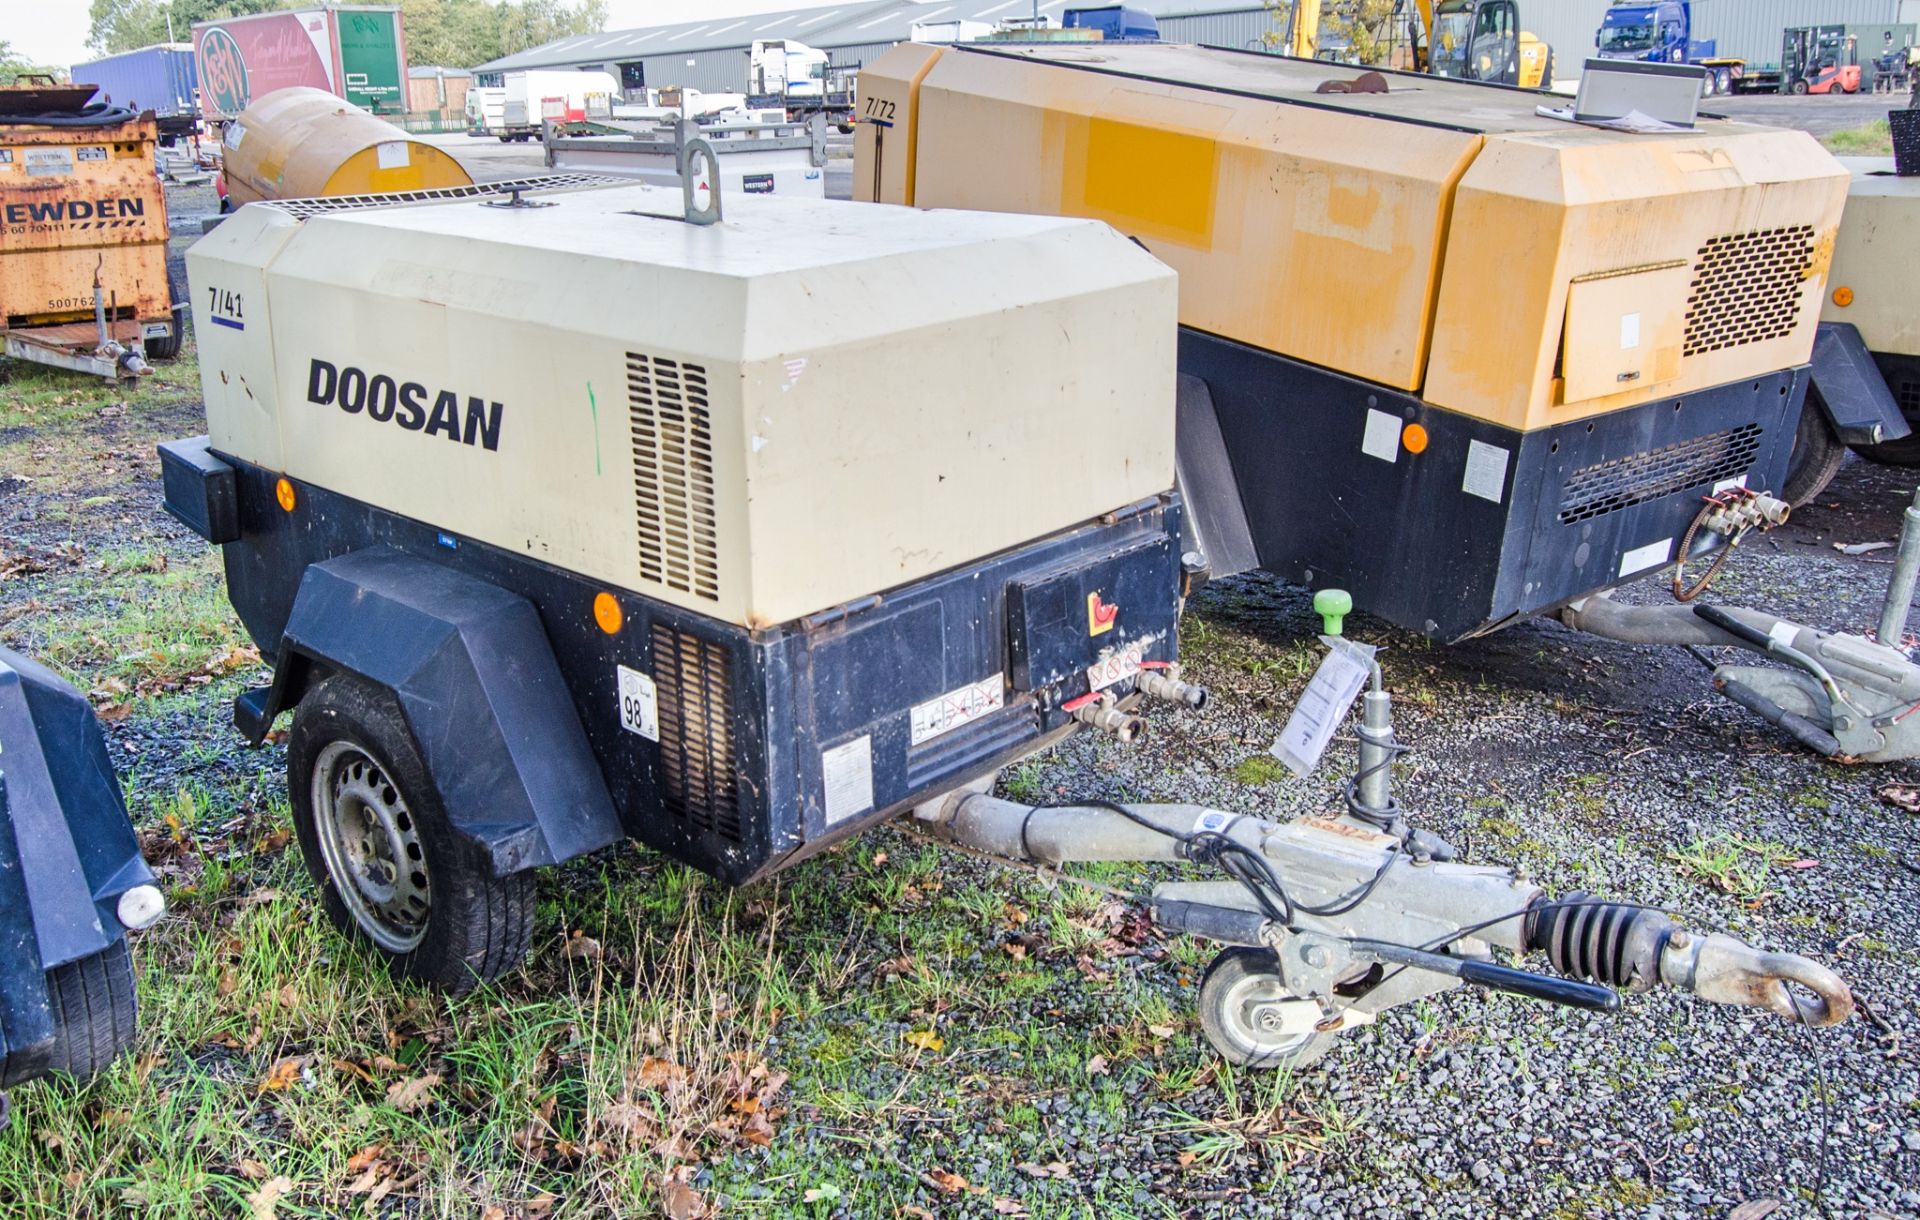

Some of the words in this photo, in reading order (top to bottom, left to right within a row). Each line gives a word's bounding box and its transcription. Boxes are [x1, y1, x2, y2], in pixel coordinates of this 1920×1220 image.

[865, 96, 896, 120] 7/72
[744, 181, 768, 190] WESTERN
[0, 198, 144, 224] EWDEN
[11, 226, 26, 234] 60
[208, 286, 243, 318] 7/41
[307, 358, 504, 452] DOOSAN
[624, 695, 642, 729] 98
